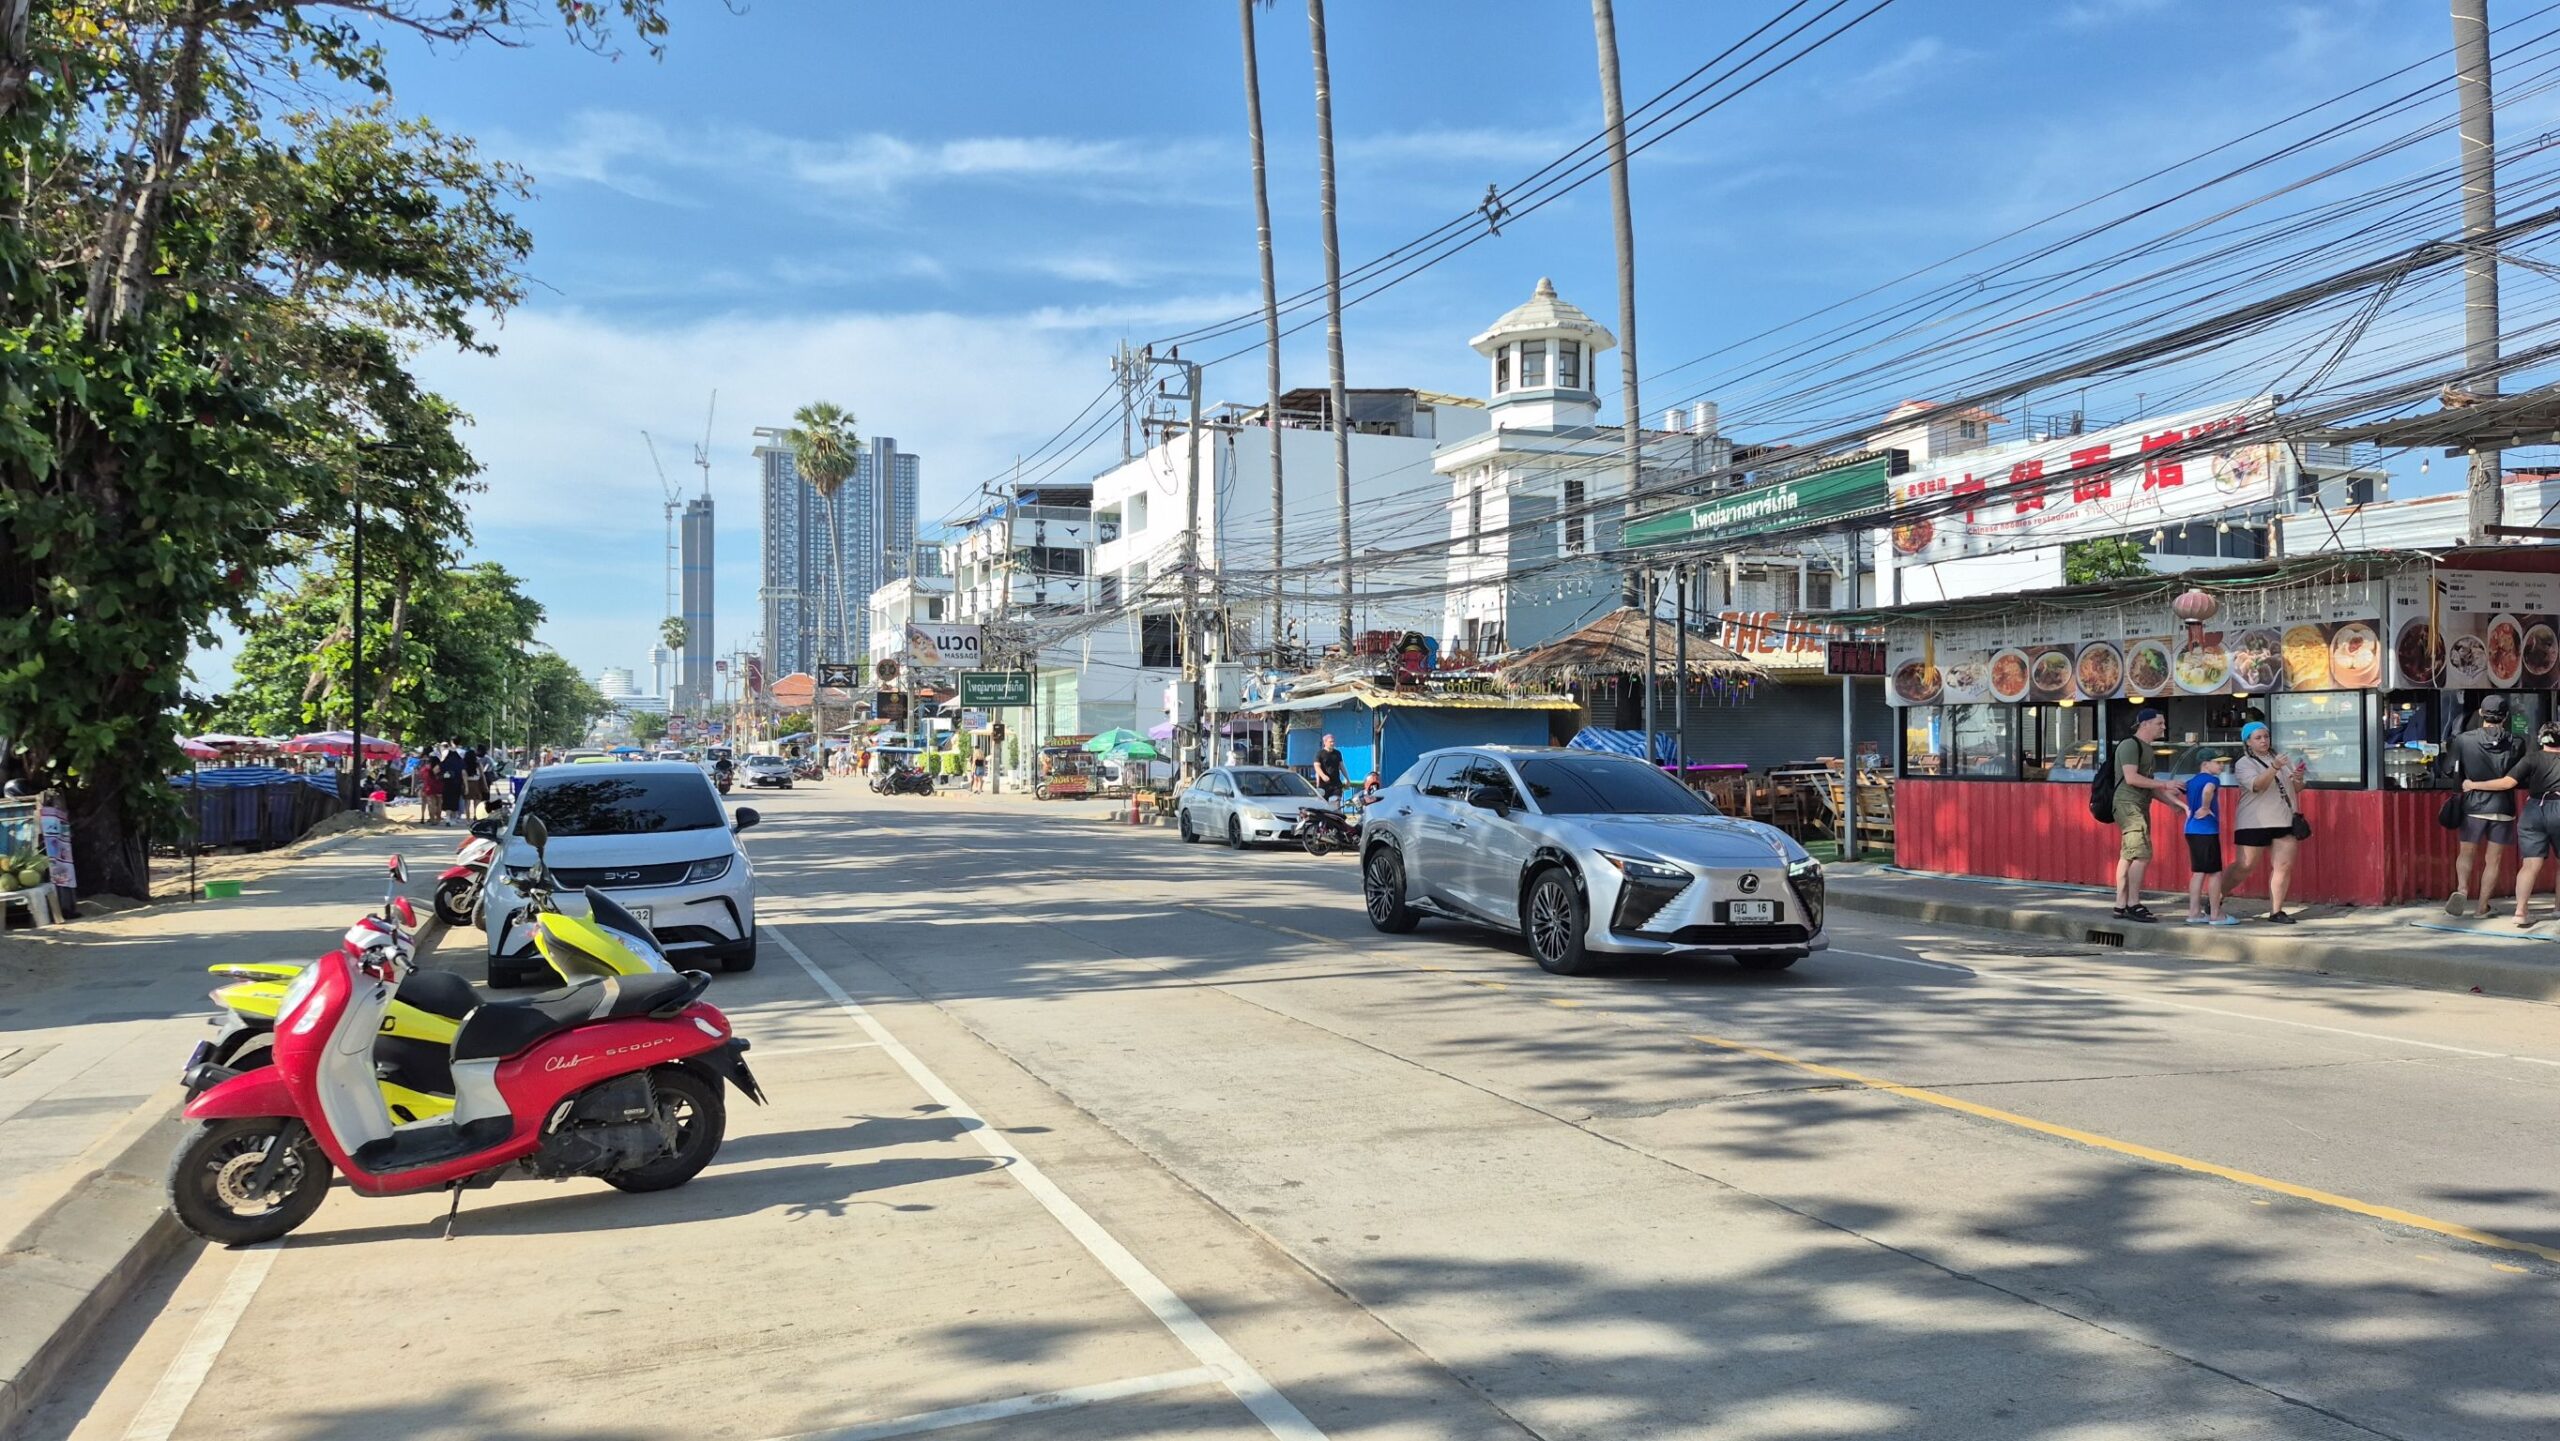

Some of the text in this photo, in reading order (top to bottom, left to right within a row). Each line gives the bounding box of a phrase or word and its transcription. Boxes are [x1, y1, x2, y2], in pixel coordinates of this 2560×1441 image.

[1966, 511, 2080, 536] Chinese noodles restaurant
[1719, 611, 1782, 654] THE
[937, 635, 978, 651] นวด
[944, 652, 979, 660] MASSAGE
[604, 871, 641, 880] BYD
[1757, 903, 1767, 913] 16
[545, 1036, 675, 1072] Club SCOOPY
